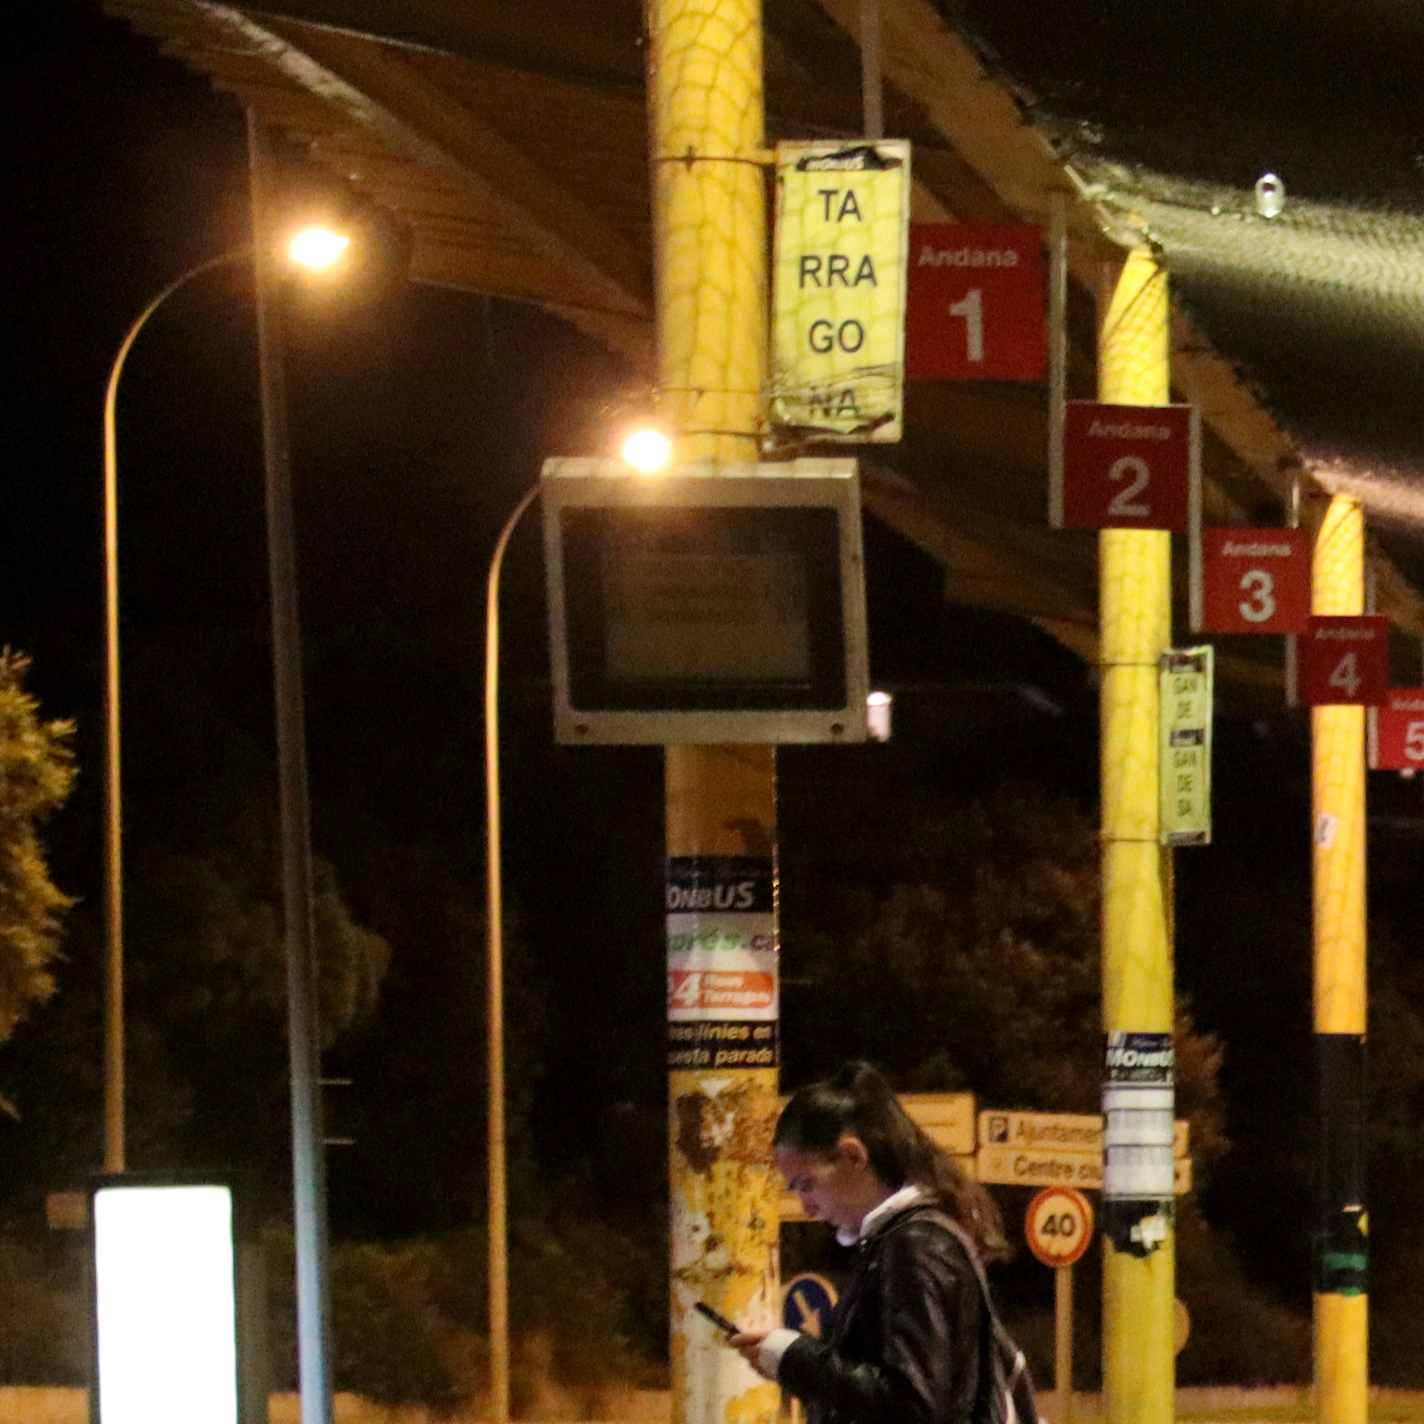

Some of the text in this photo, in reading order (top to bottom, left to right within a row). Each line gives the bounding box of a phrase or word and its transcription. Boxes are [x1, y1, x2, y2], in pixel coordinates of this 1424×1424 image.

[818, 189, 862, 222] TA
[800, 254, 878, 288] RRA
[918, 245, 1018, 267] Andana
[809, 319, 864, 353] GO
[949, 289, 984, 361] 1
[809, 387, 859, 417] NA
[1087, 421, 1171, 440] Andana
[1108, 456, 1150, 517] 2
[1222, 541, 1292, 556] Andana
[1240, 569, 1276, 622] 3
[1329, 652, 1361, 697] 4
[1014, 1156, 1073, 1179] Centre
[1042, 1213, 1075, 1238] 40
